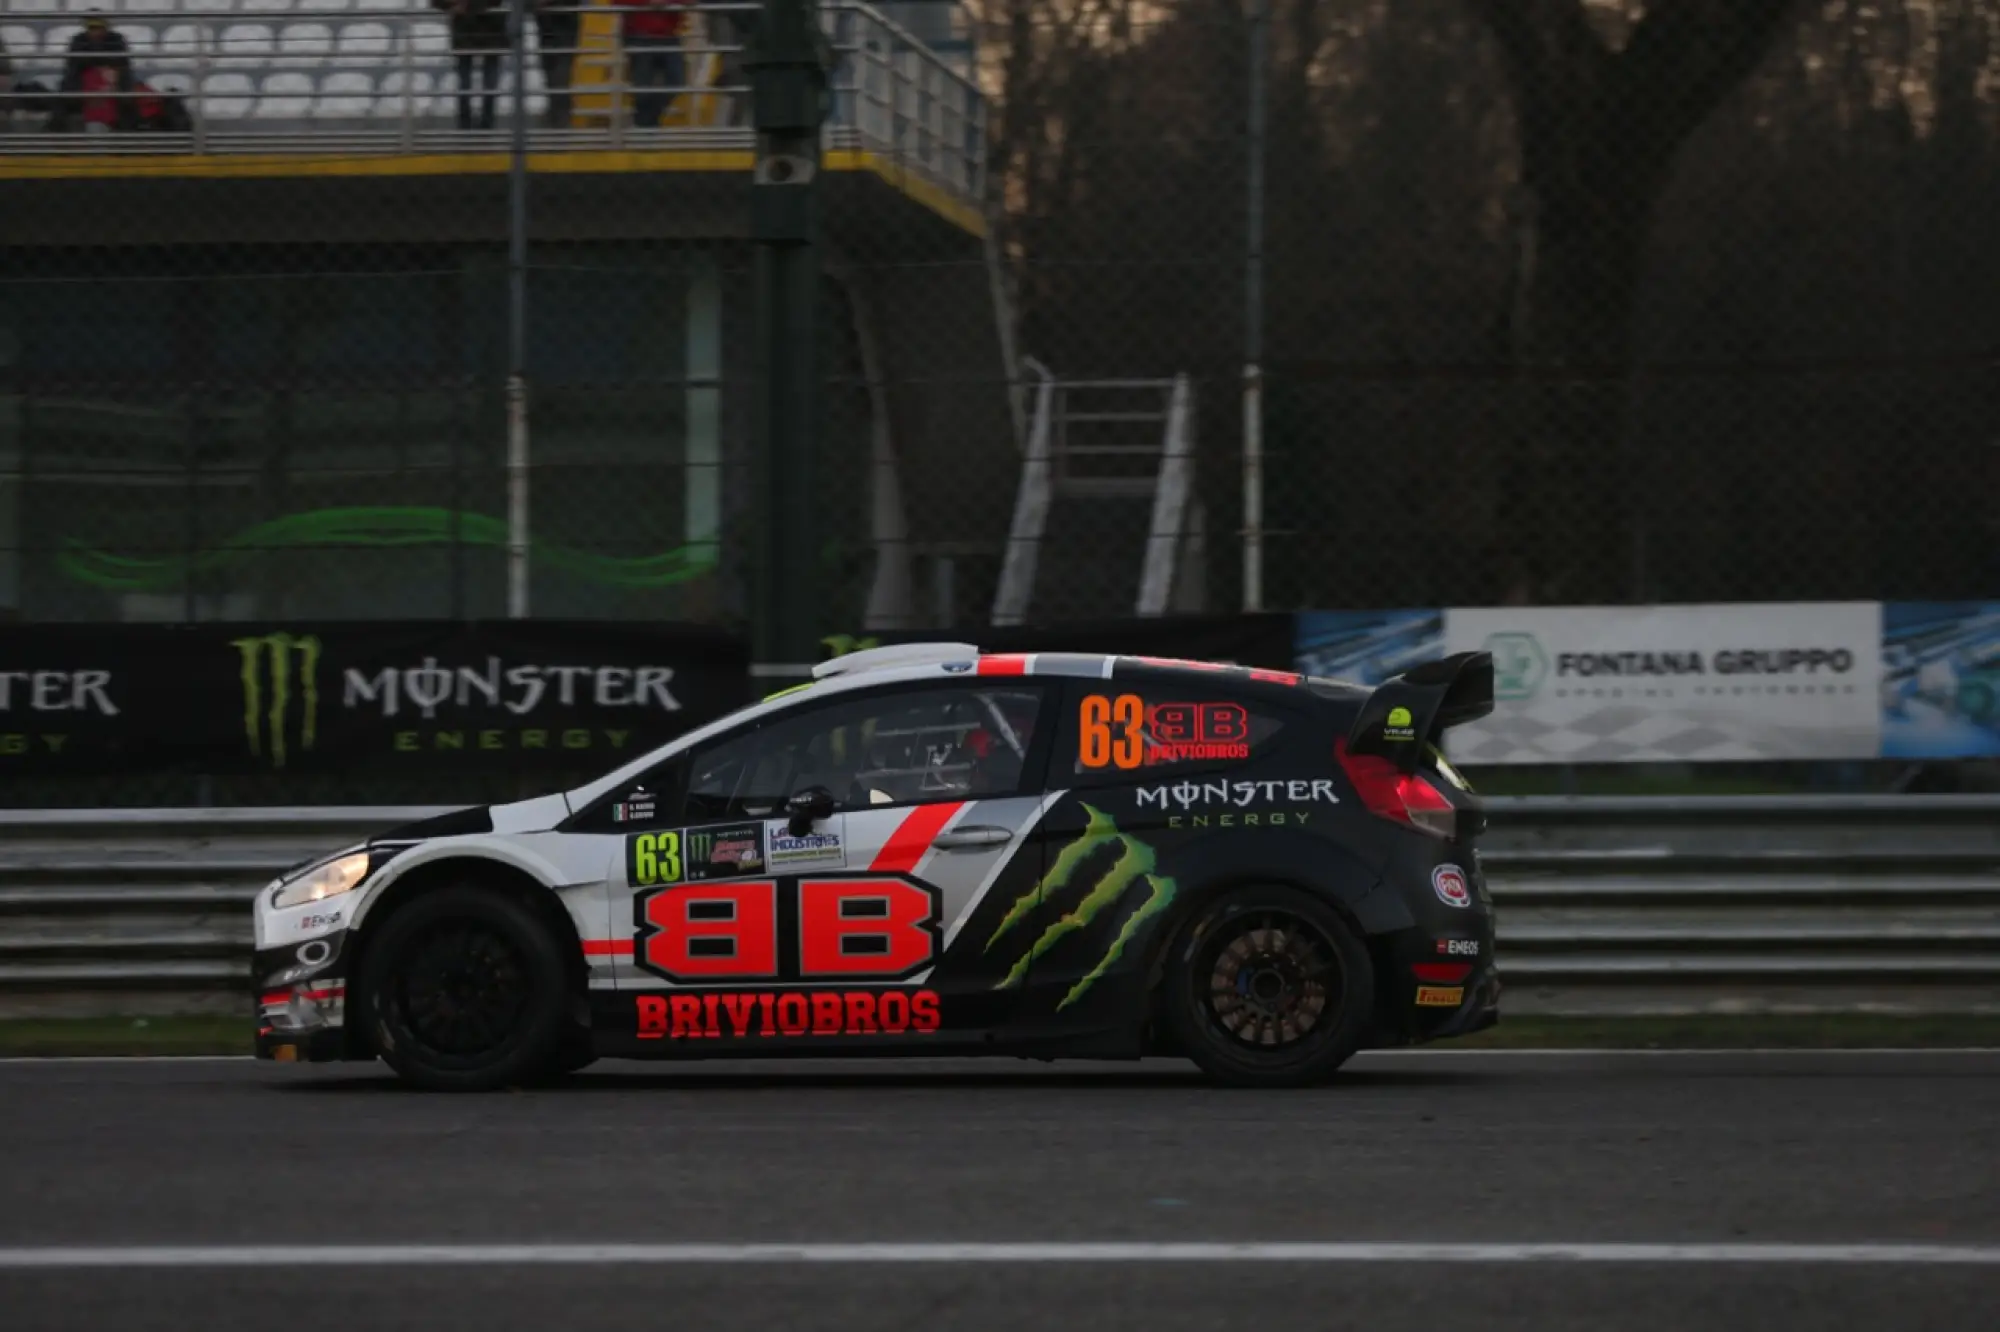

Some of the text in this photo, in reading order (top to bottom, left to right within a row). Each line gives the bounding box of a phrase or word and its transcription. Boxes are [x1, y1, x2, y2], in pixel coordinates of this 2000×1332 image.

[1558, 648, 1852, 677] FONTANA GRUPPO
[345, 656, 681, 718] MONSTER
[397, 731, 630, 750] ENERGY
[1079, 693, 1144, 770] 63
[1136, 779, 1340, 811] MONSTER
[1170, 812, 1310, 828] ENERGY
[636, 832, 682, 884] 63
[1447, 939, 1480, 955] ENEOS
[635, 990, 942, 1039] BRIVIOBROS
